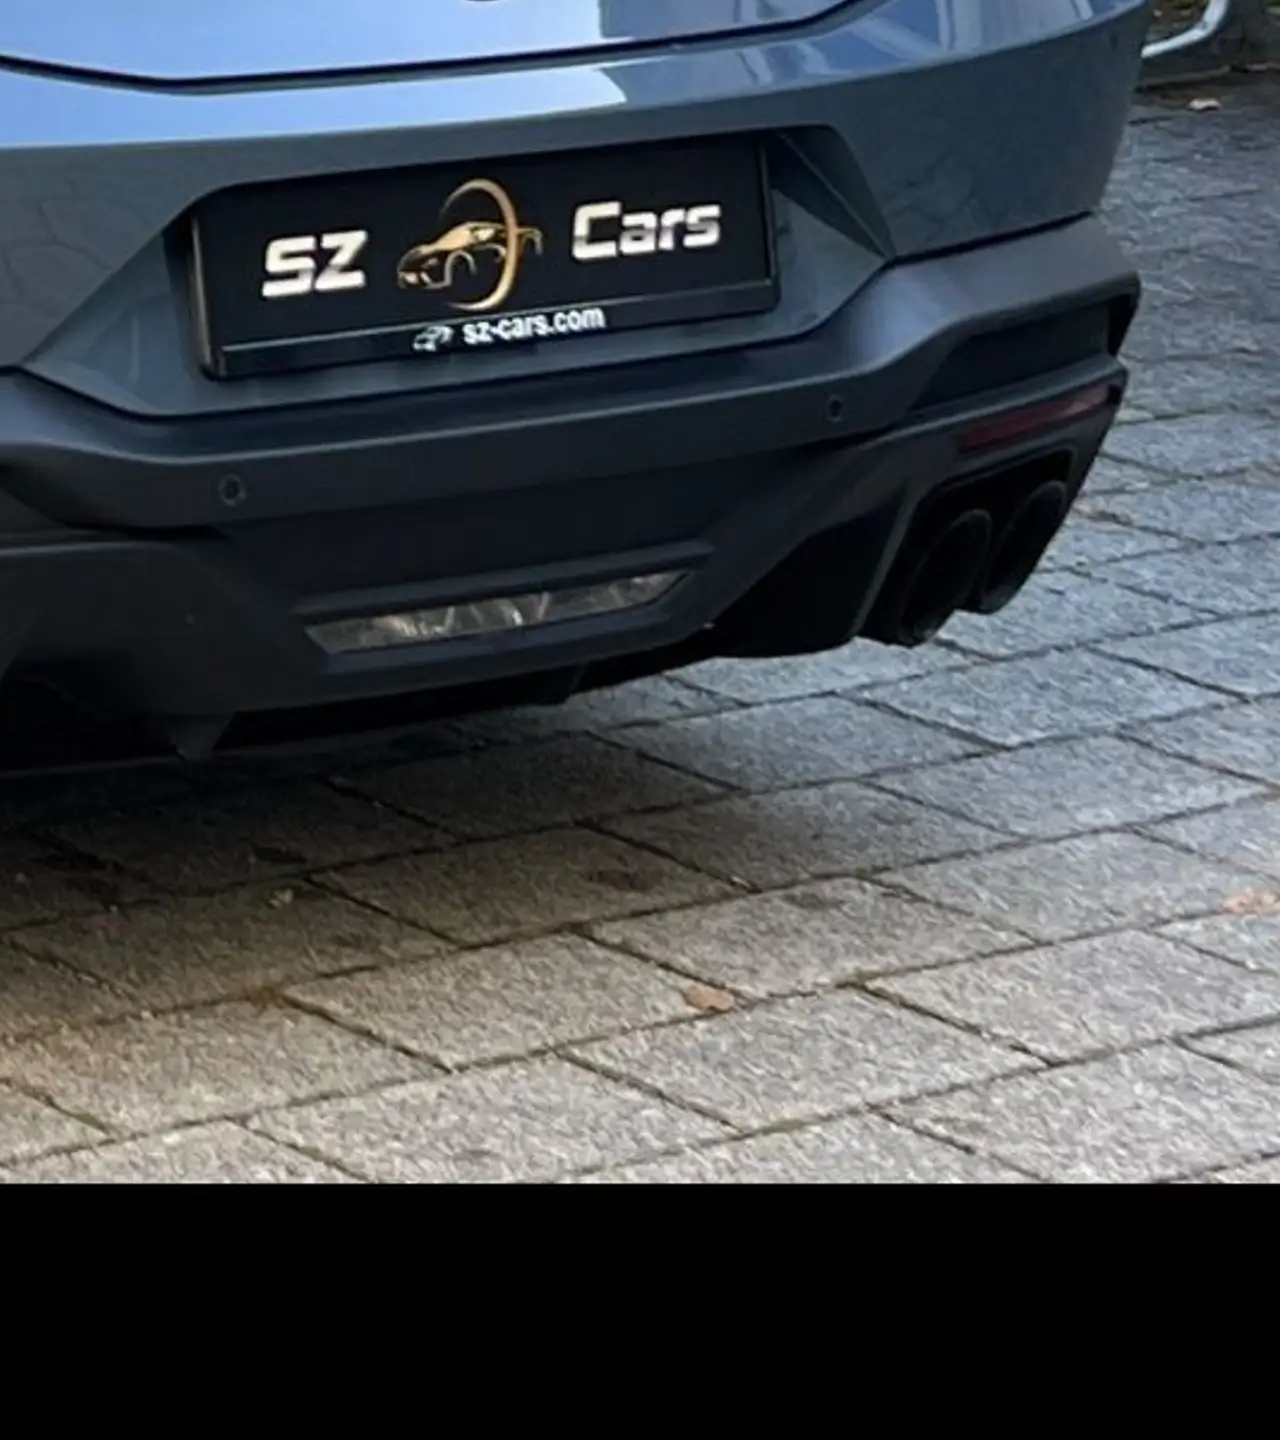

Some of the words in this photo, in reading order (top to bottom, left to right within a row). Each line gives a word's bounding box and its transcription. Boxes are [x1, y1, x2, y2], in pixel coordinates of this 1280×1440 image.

[261, 229, 368, 299] SZ
[571, 201, 721, 261] Cars
[461, 306, 608, 346] sz-cars.com
